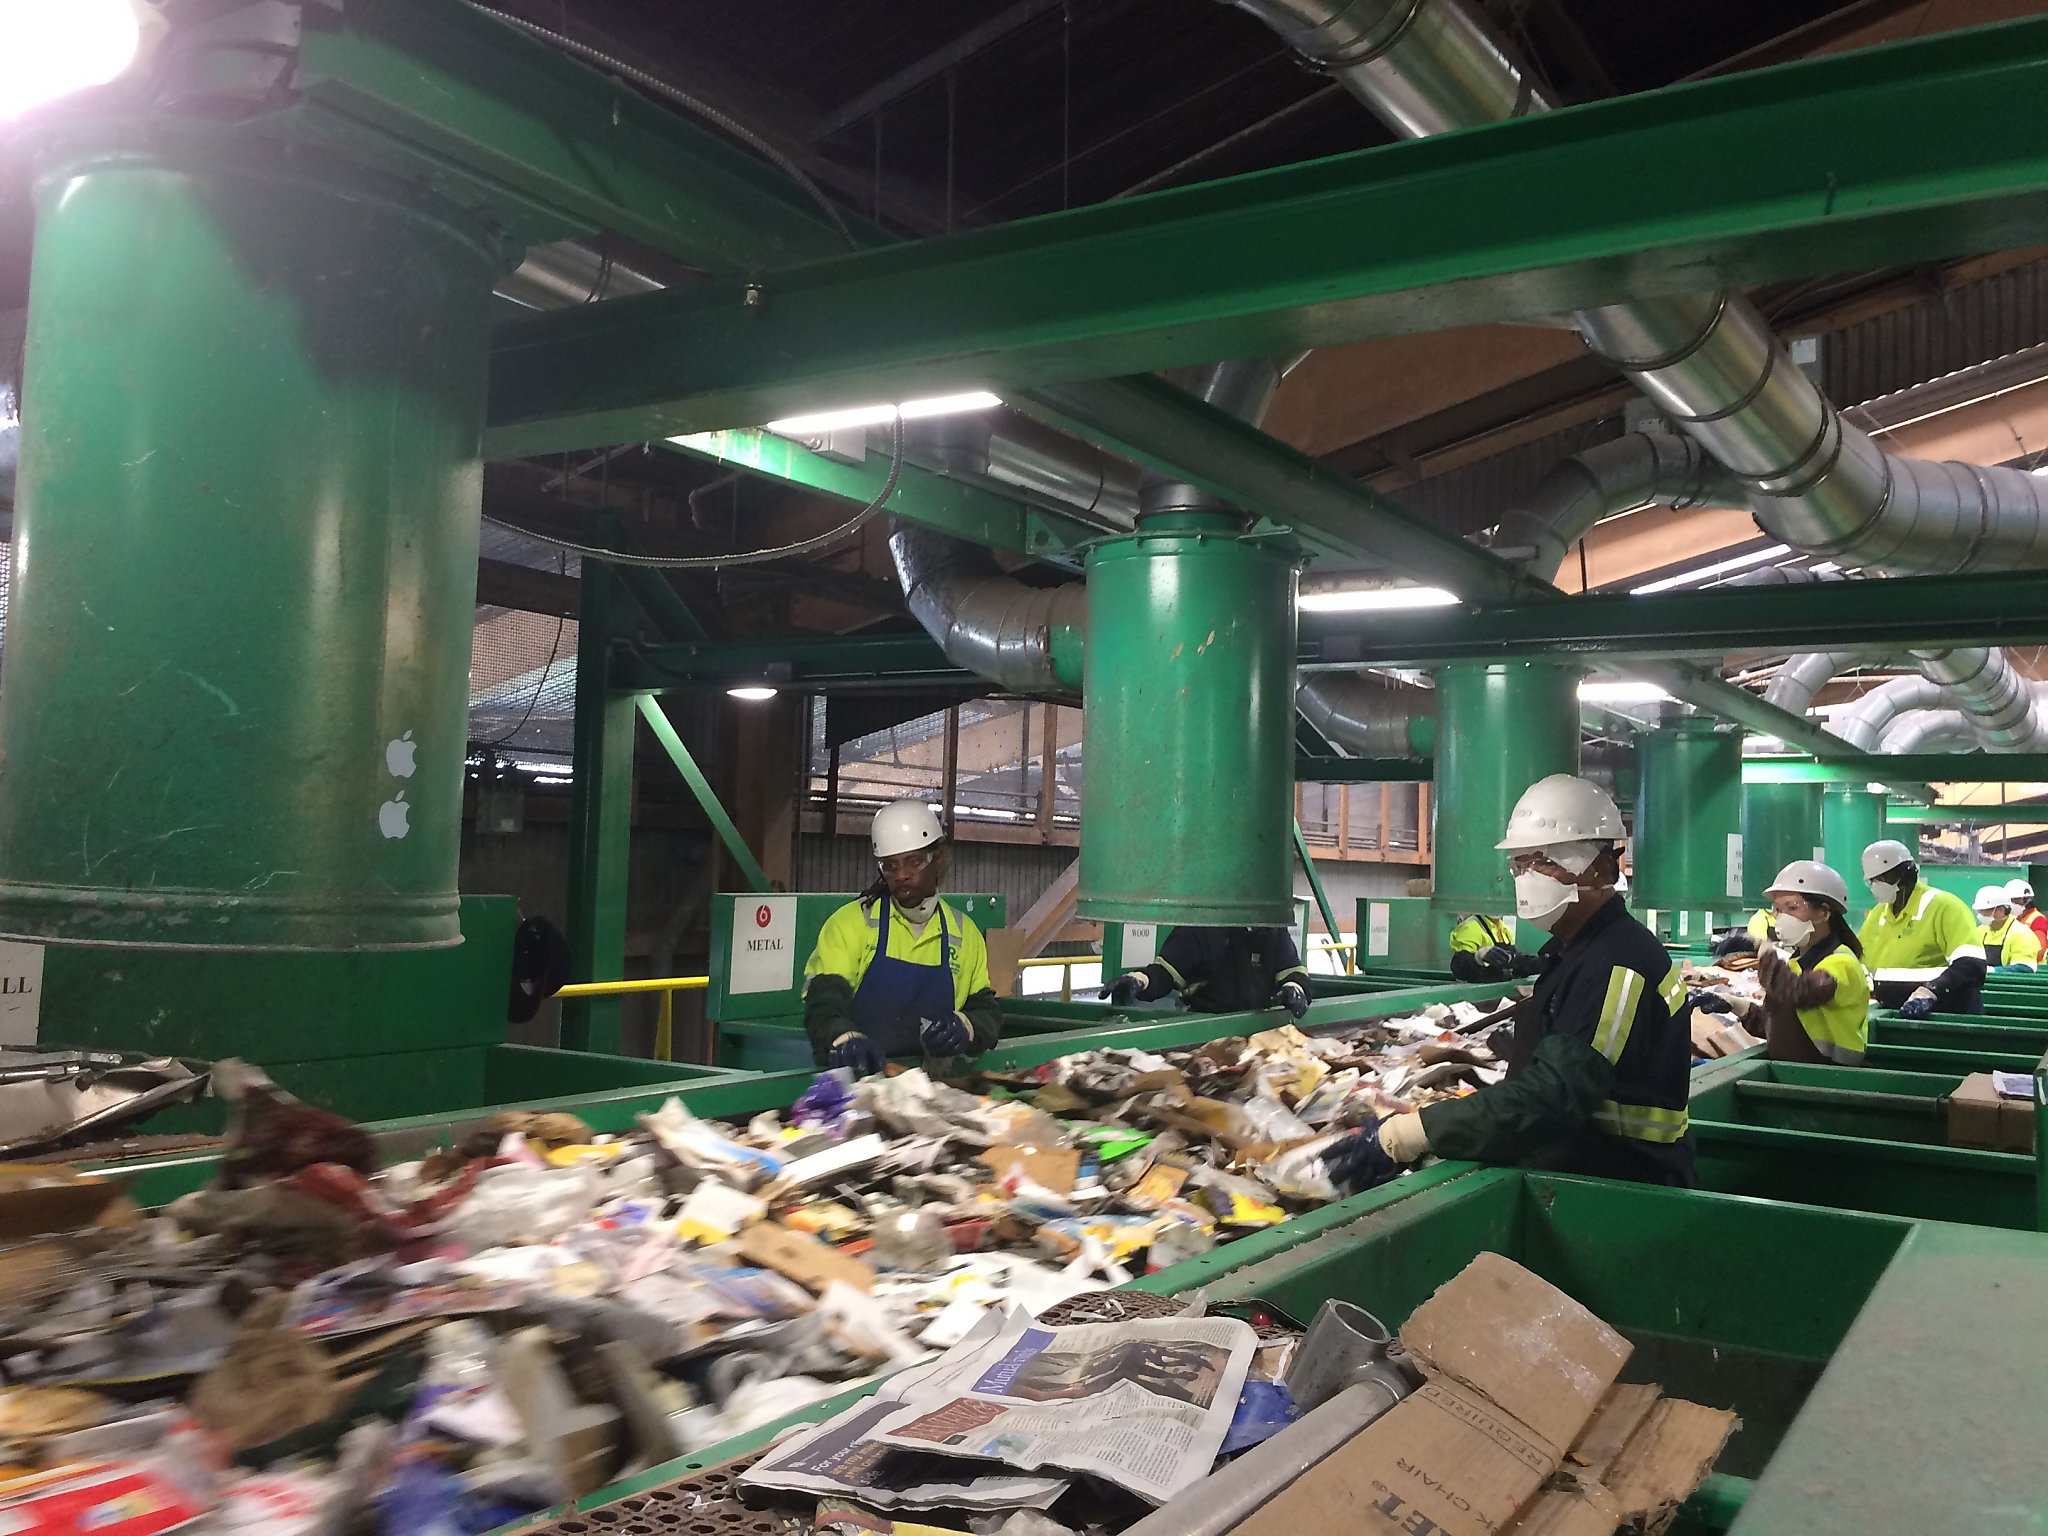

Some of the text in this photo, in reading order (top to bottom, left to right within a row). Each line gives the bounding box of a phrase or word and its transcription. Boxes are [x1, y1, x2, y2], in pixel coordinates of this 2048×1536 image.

[1131, 928, 1150, 938] WOOD
[747, 938, 784, 952] METAL
[978, 1361, 1022, 1394] Mutual
[1424, 1386, 1544, 1466] REQUIRED
[809, 1459, 832, 1473] For
[1396, 1457, 1471, 1511] CHAIR
